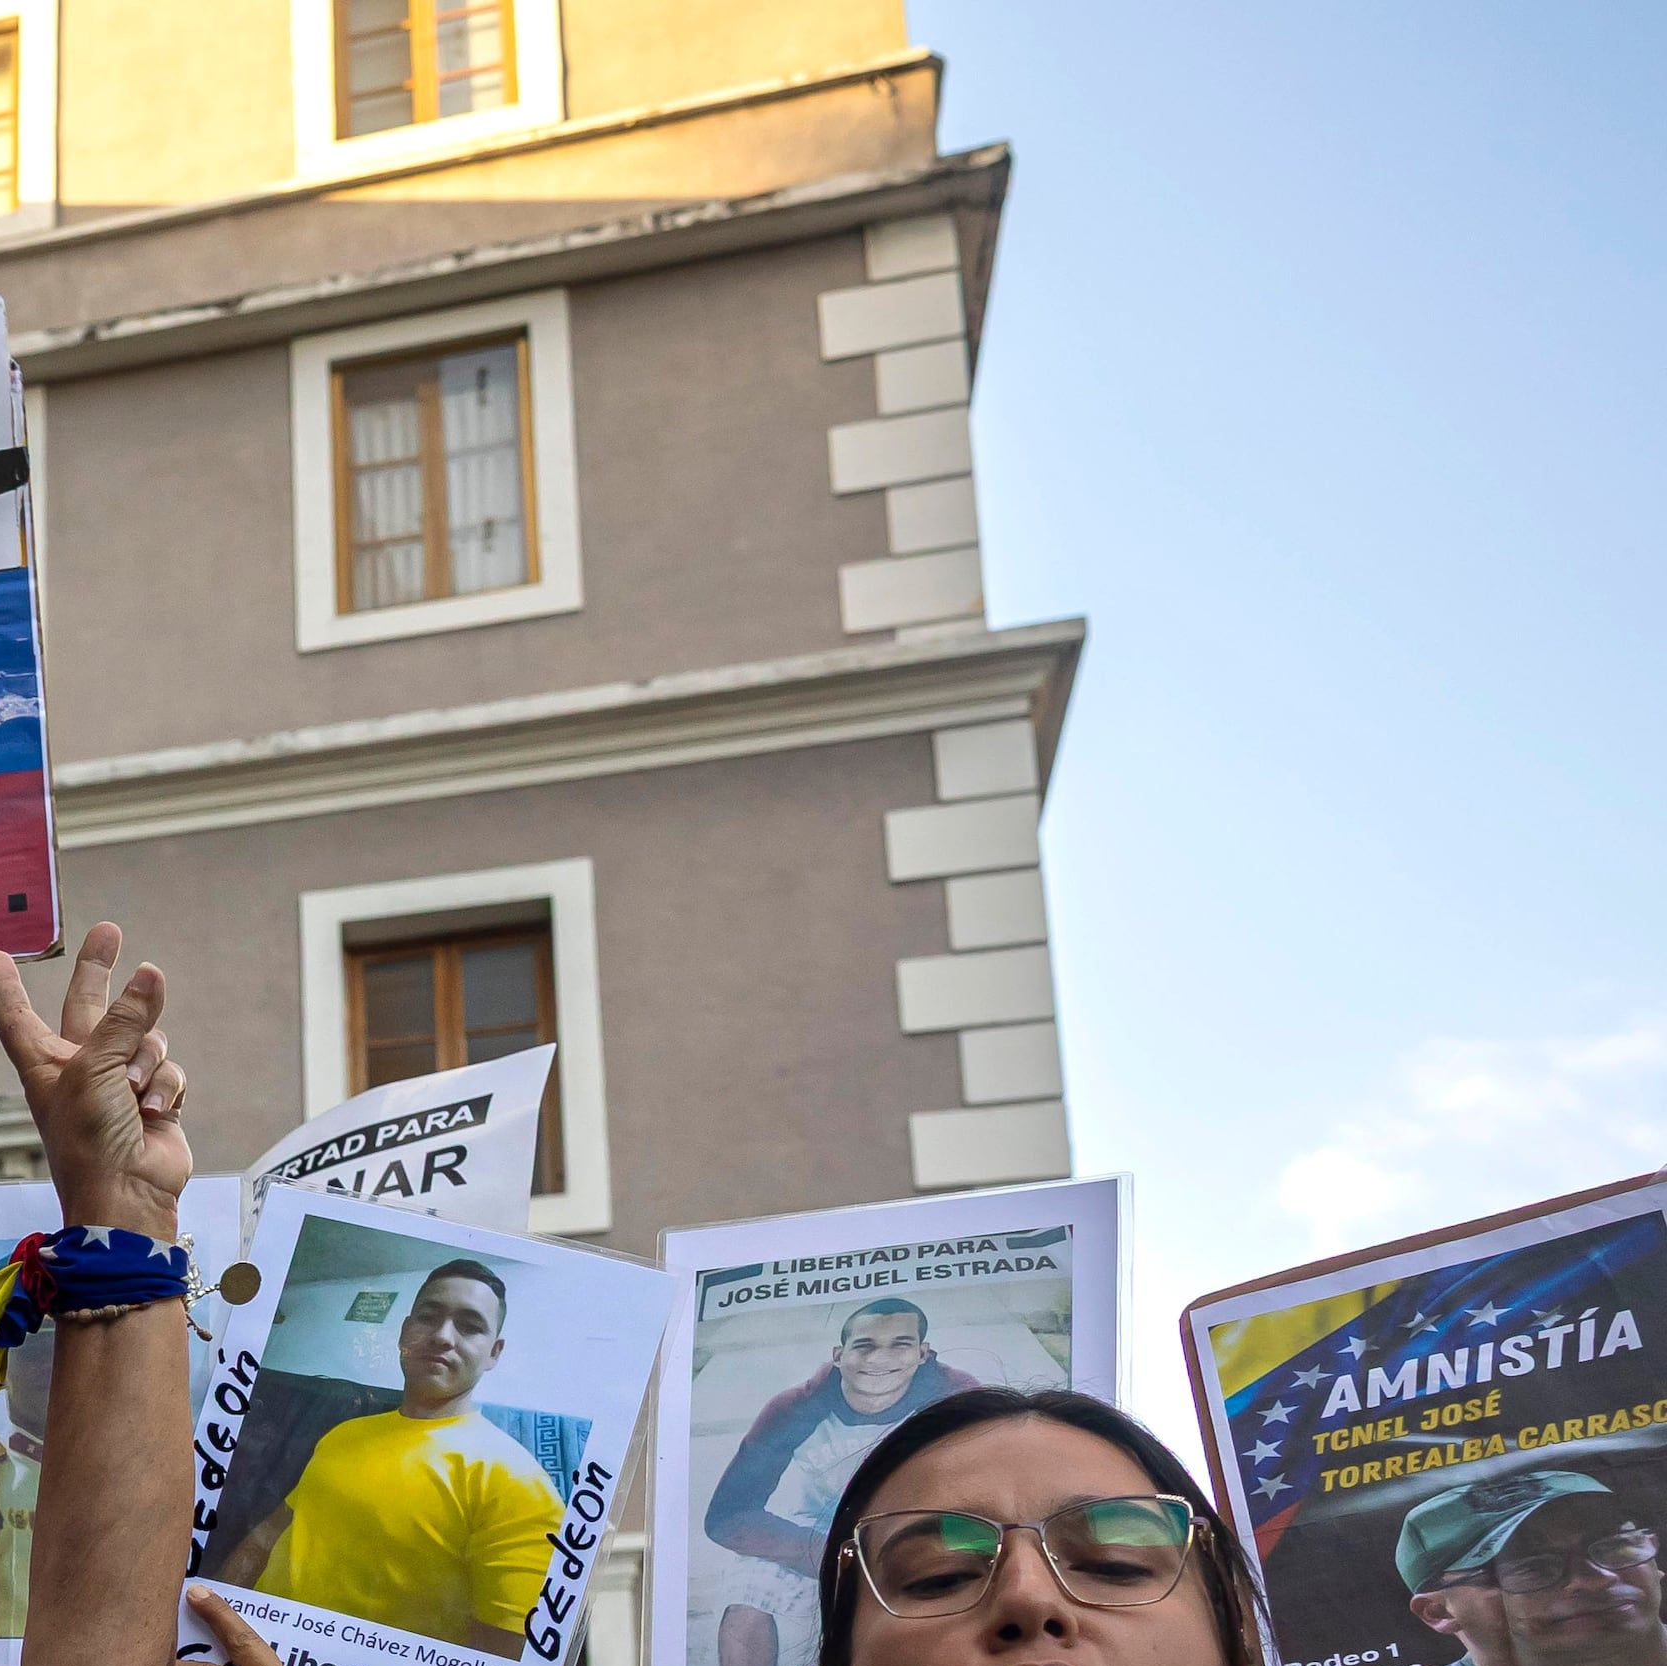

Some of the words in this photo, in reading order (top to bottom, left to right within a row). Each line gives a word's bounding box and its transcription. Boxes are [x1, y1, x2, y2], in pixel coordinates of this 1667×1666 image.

[375, 1105, 476, 1148] PARA
[717, 1278, 790, 1309] JOSÉ
[795, 1267, 909, 1297] MIGUEL
[915, 1253, 1059, 1282] ESTRADA
[772, 1243, 912, 1277] LIBERTAD
[917, 1236, 999, 1258] PARA
[1319, 1305, 1643, 1420] AMNISTÍA
[1312, 1416, 1410, 1456] TCNEL
[1420, 1389, 1502, 1434] JOSÉ
[1320, 1433, 1507, 1494] TORREALBA
[1517, 1398, 1667, 1451] CARRASC
[292, 1612, 336, 1638] José
[341, 1625, 411, 1659] Chávez
